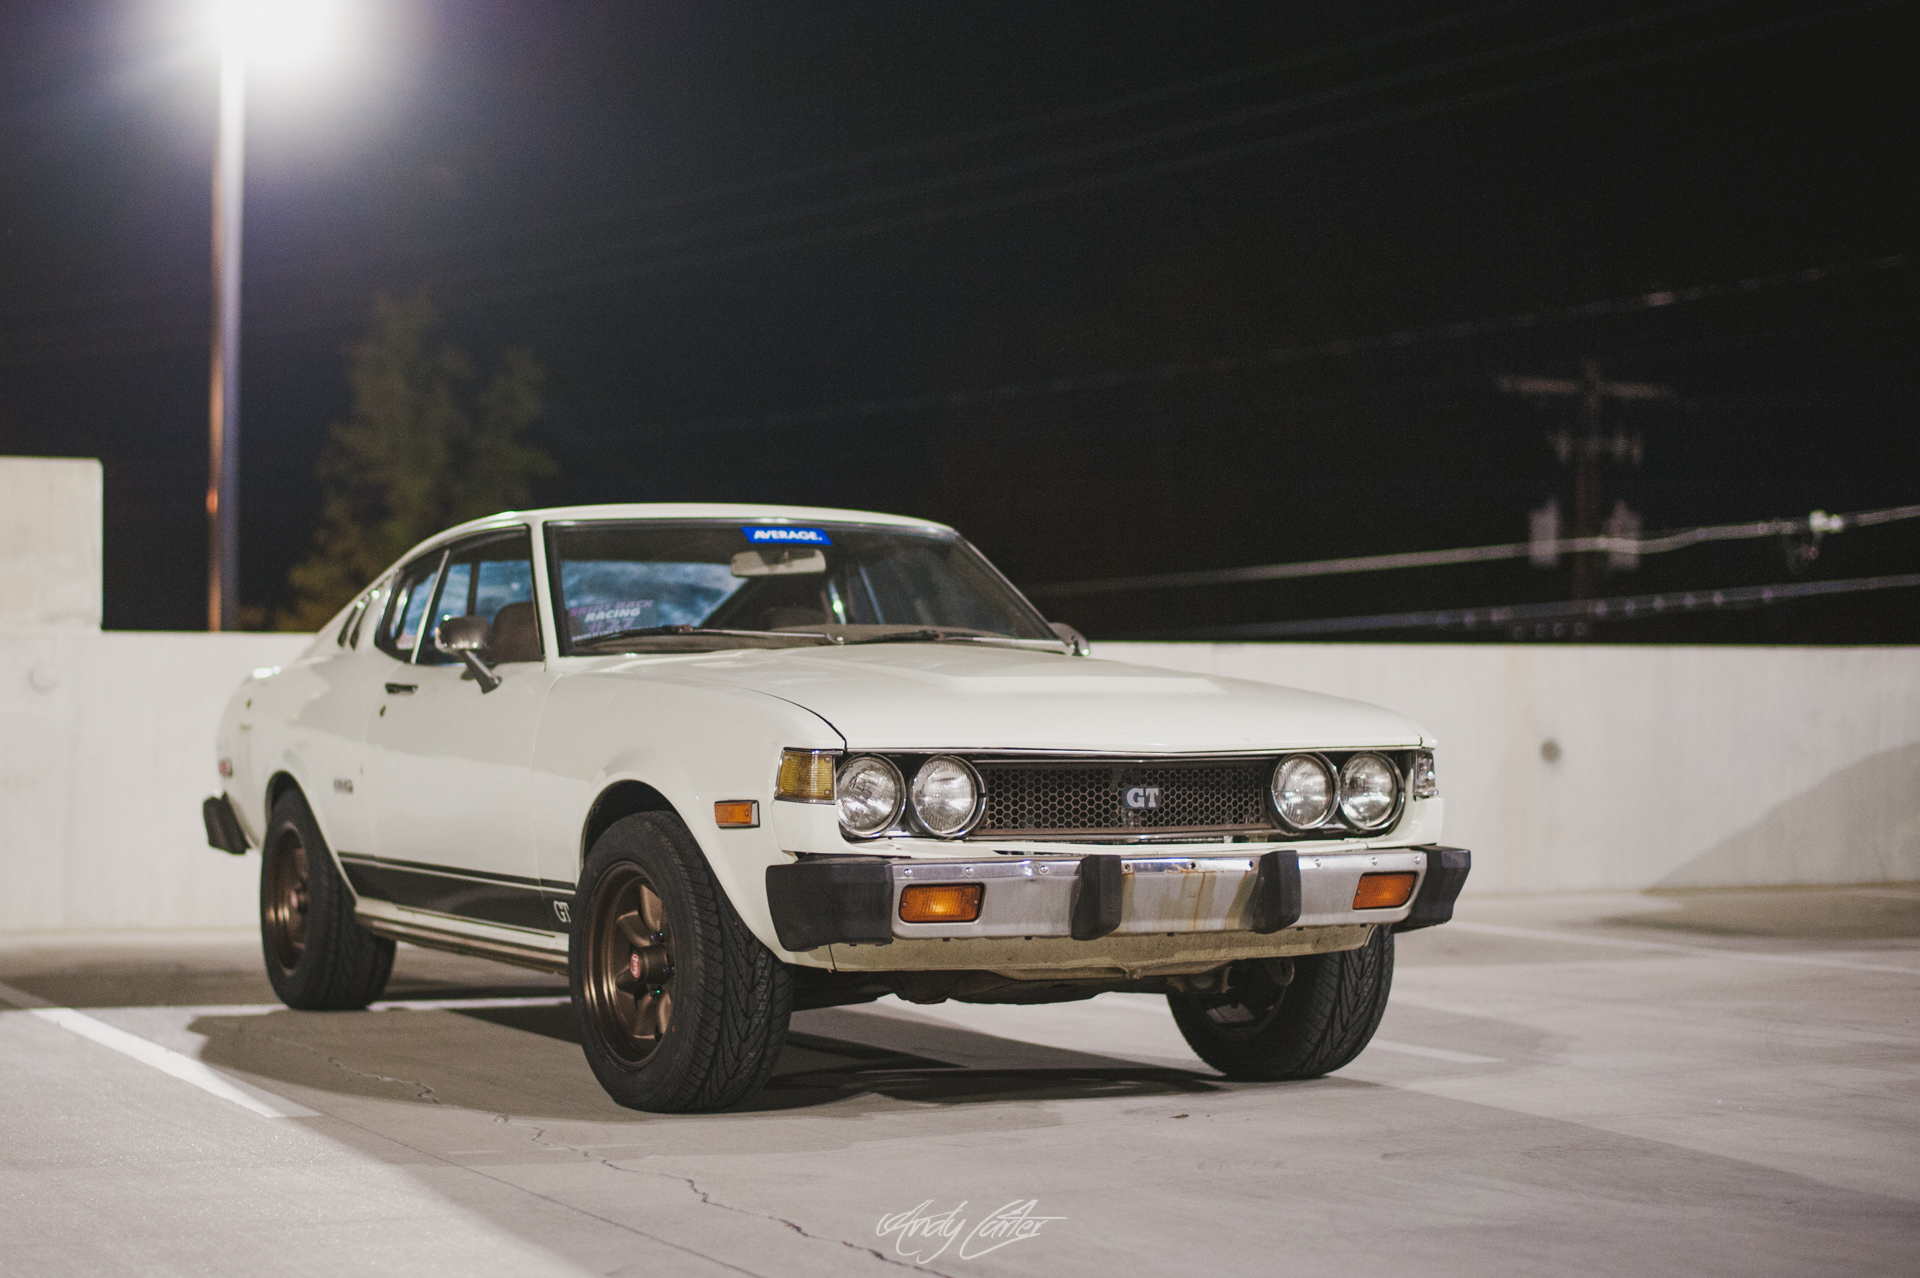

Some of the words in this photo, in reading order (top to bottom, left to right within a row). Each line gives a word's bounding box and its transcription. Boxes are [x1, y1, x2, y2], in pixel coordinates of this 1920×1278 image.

[753, 530, 823, 541] AVERAGE.
[585, 607, 641, 623] RACING
[1126, 787, 1159, 808] GT
[553, 900, 571, 923] GT
